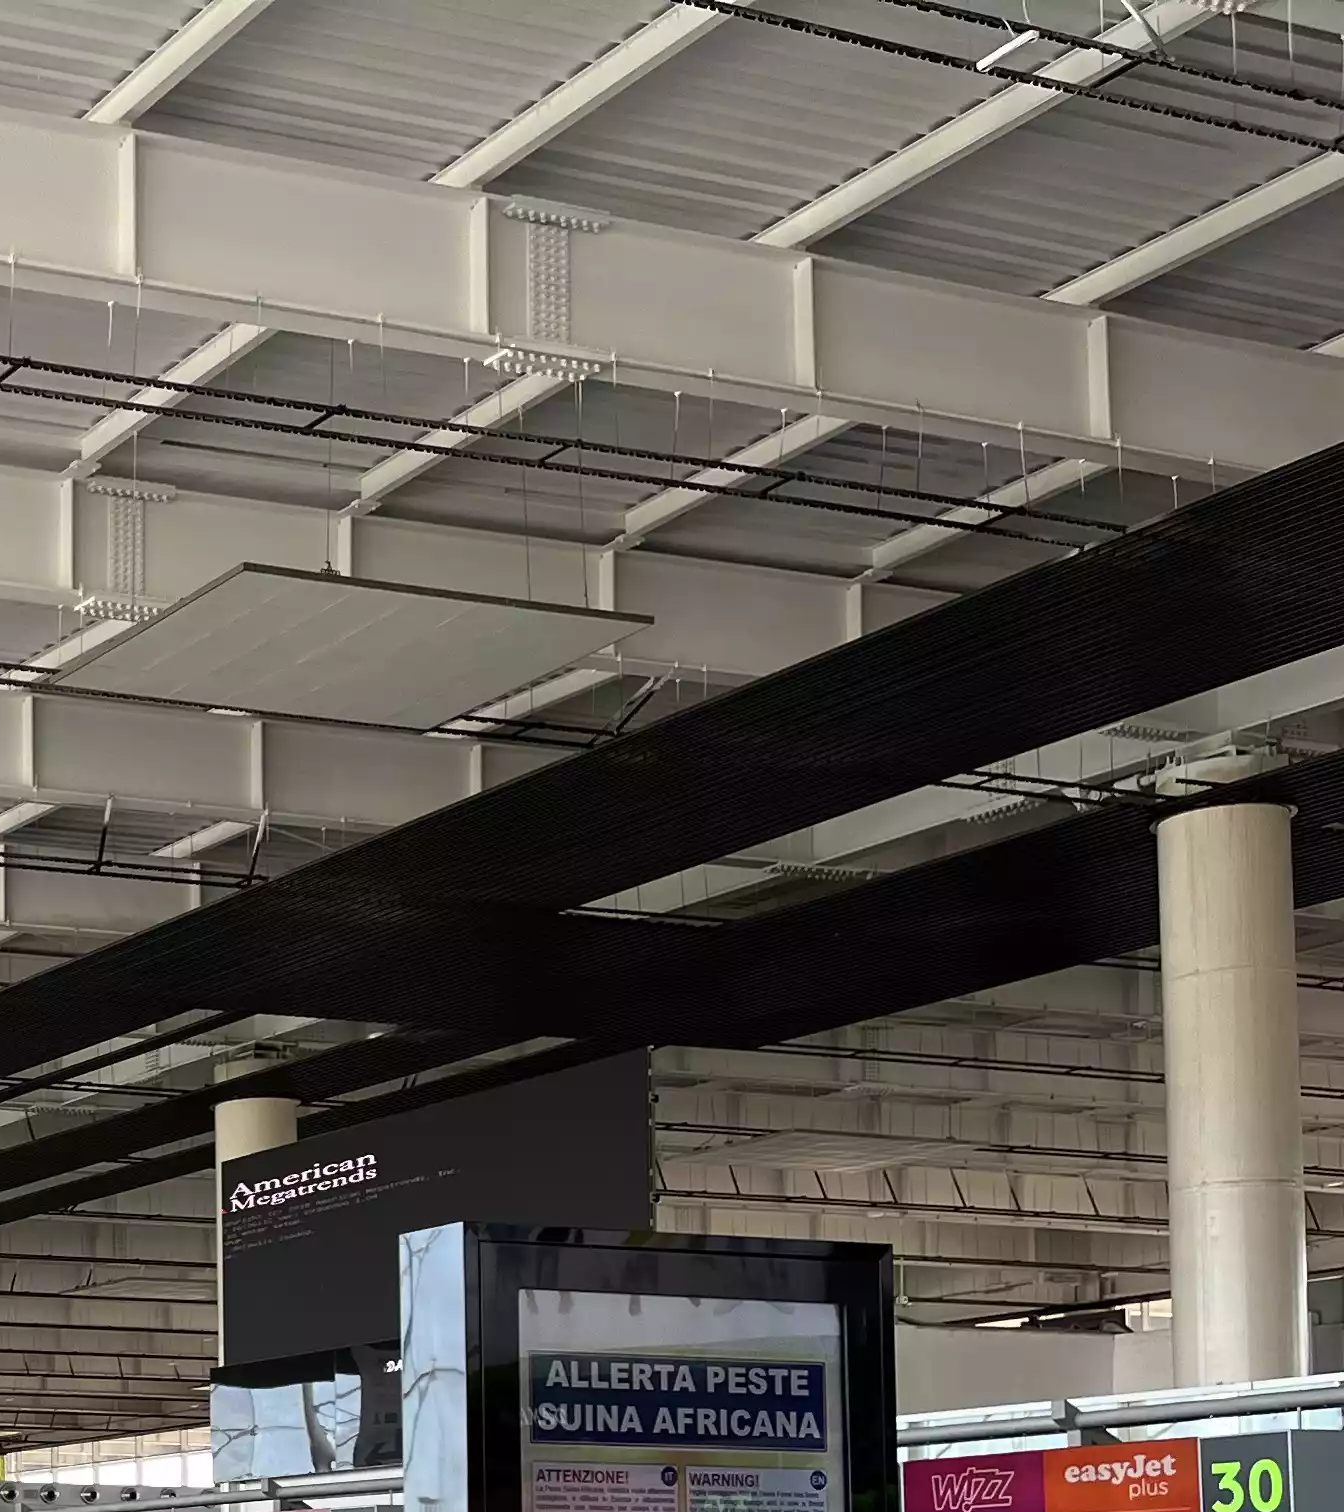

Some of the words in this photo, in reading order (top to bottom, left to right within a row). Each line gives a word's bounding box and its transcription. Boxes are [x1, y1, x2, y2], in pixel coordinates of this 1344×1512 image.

[229, 1152, 377, 1200] American
[230, 1166, 378, 1214] Megatrends
[545, 1360, 696, 1392] ALLERTA
[706, 1366, 810, 1396] PESTE
[537, 1402, 643, 1433] SUINA
[653, 1406, 821, 1439] AFRICANA
[536, 1468, 630, 1485] ATTENZIONE!
[664, 1471, 675, 1482] IT
[688, 1472, 760, 1488] WARNING!
[811, 1475, 826, 1486] EN
[1064, 1453, 1177, 1486] easyJet
[1128, 1479, 1169, 1501] plus
